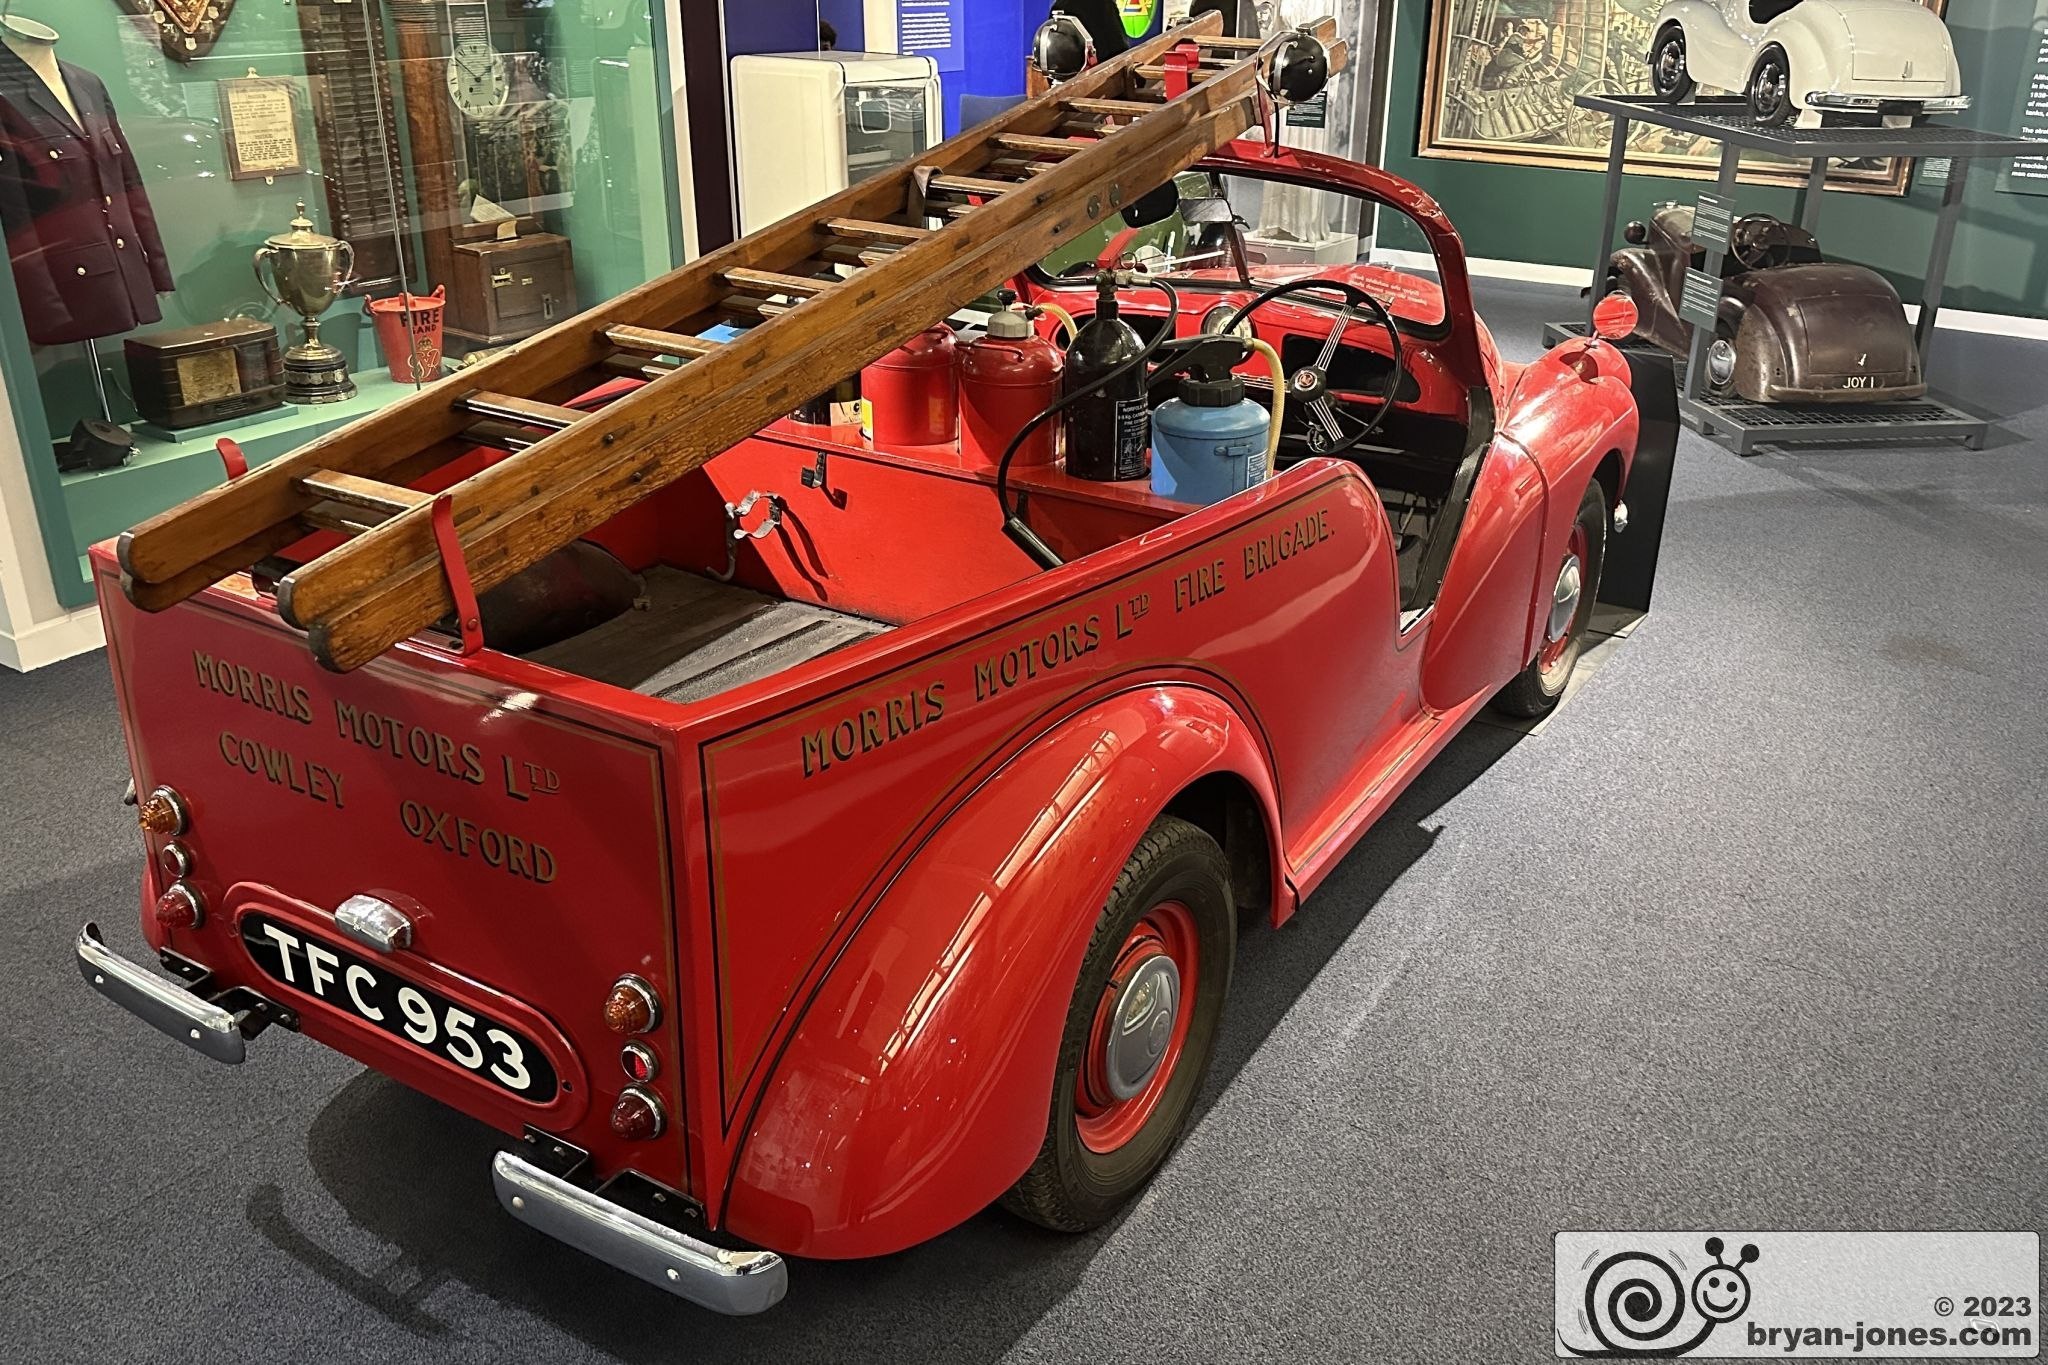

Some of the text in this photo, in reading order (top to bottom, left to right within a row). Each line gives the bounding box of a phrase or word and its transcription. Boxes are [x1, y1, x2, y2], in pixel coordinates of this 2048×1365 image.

[400, 309, 439, 327] FIRE
[1842, 376, 1867, 389] JOY
[802, 681, 945, 778] MORRIS
[974, 614, 1101, 702] MOTORS
[1174, 559, 1225, 613] FIRE
[1243, 509, 1335, 580] BRIGADE.
[193, 649, 313, 724] MORRIS
[336, 698, 486, 784] MOTORS
[219, 730, 558, 884] COWLEY OXFORD
[263, 923, 531, 1090] TFC 953
